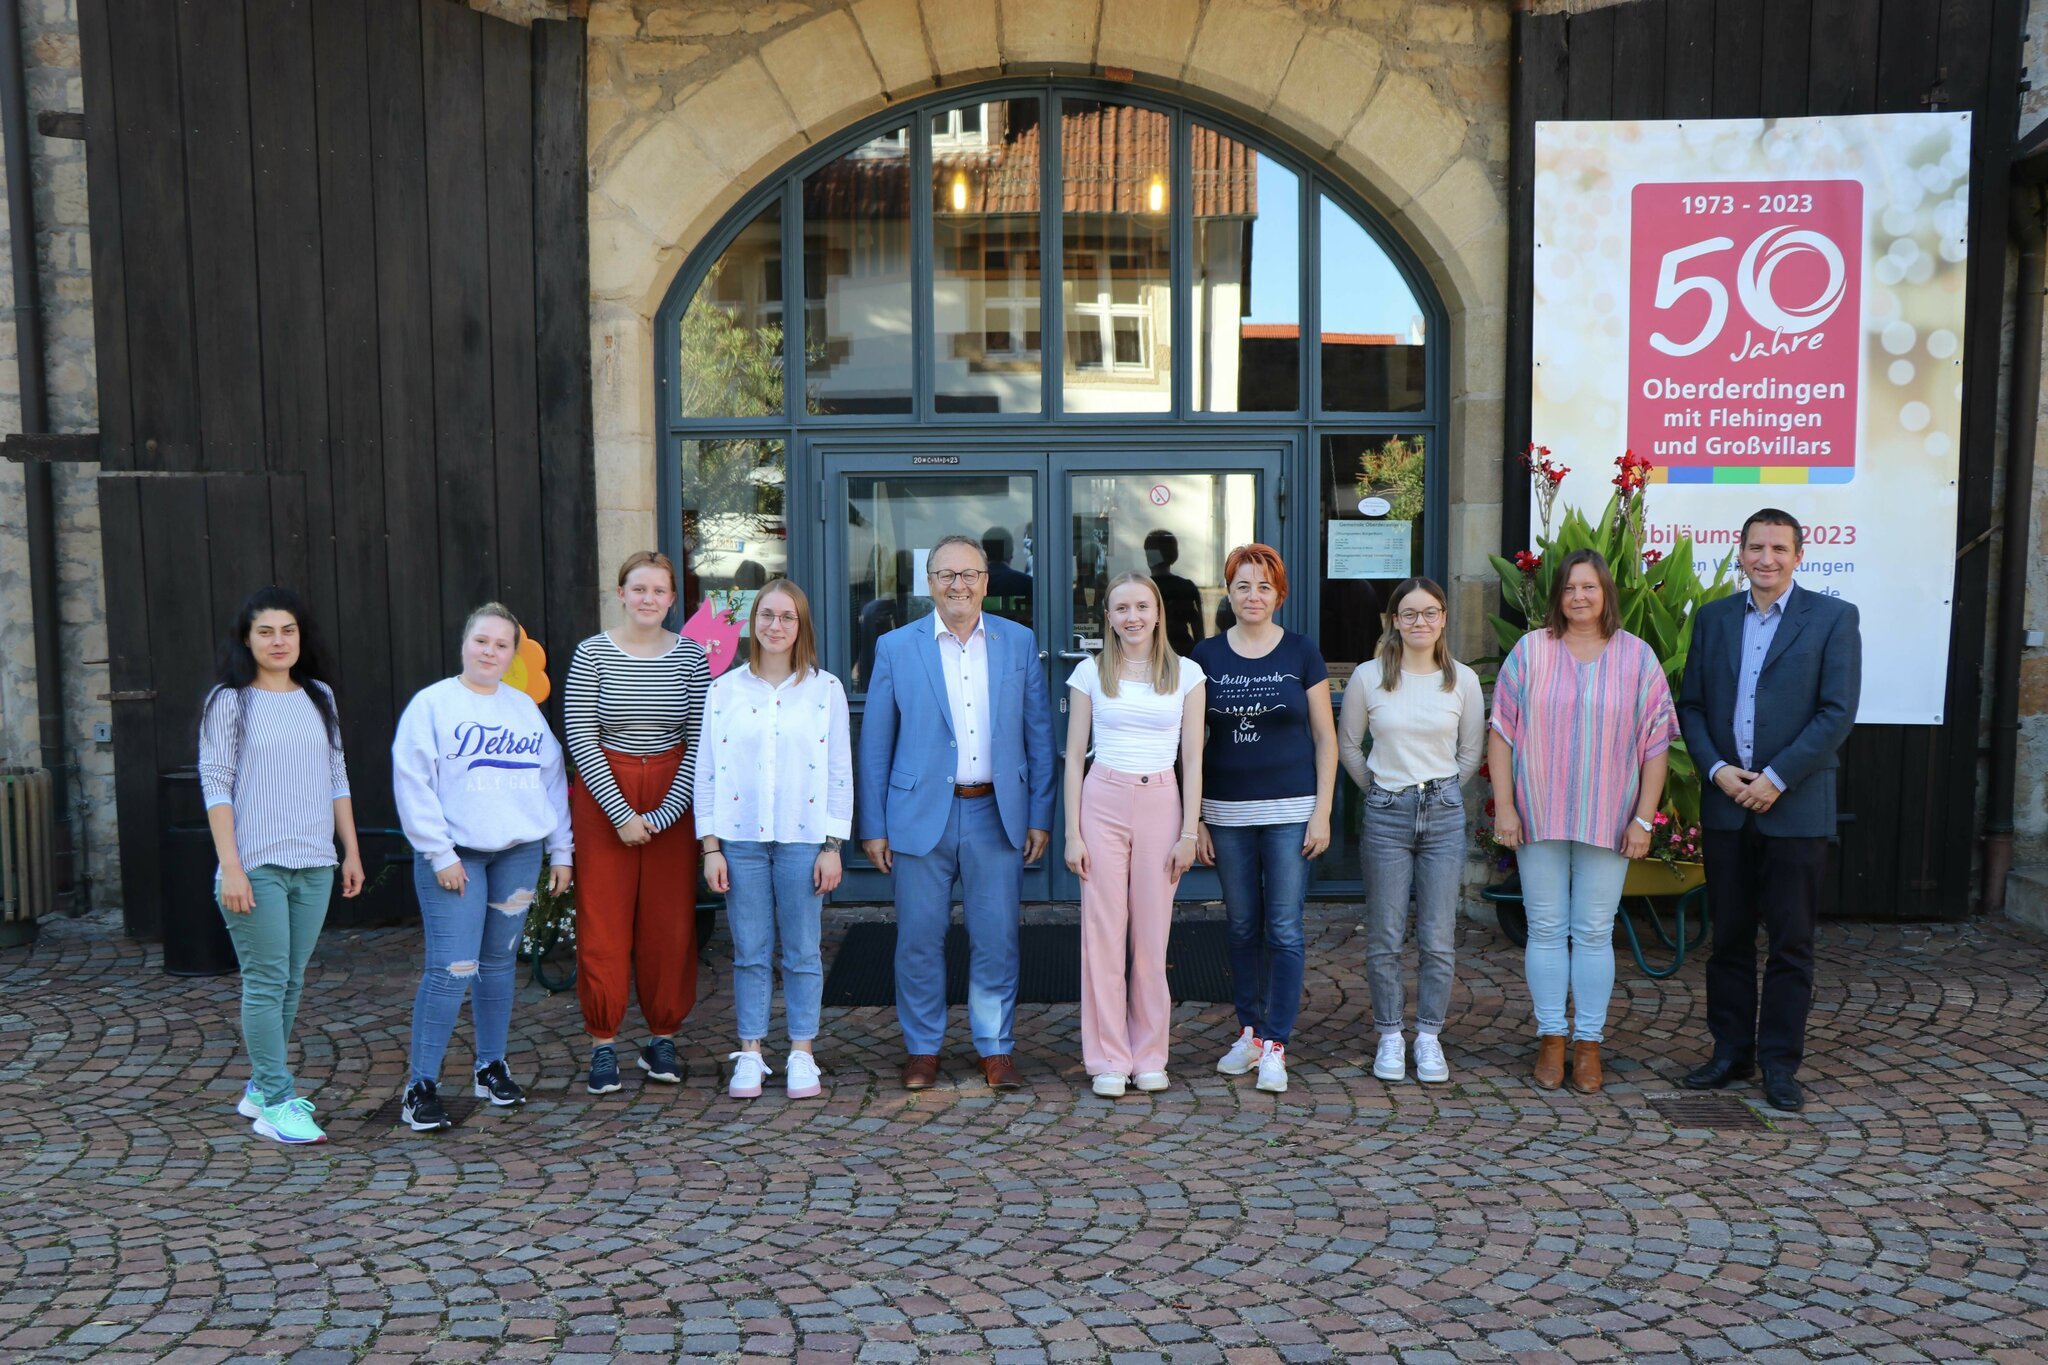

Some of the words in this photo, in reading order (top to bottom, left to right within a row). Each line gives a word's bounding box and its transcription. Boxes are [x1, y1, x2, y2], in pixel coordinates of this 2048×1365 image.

[1682, 196, 1734, 214] 1973
[1758, 194, 1813, 213] 2023
[1650, 224, 1847, 357] 50
[1730, 326, 1824, 362] Jahre
[1642, 377, 1846, 405] Oberderdingen
[1663, 408, 1702, 427] mit
[1709, 408, 1822, 432] Flehingen
[1653, 436, 1697, 455] und
[1705, 436, 1831, 455] Großvillars
[1800, 525, 1857, 545] 2023
[1216, 674, 1252, 687] Pretty
[1251, 672, 1286, 683] words
[1240, 716, 1255, 730] &
[446, 721, 543, 760] Detroit
[1232, 729, 1260, 743] true
